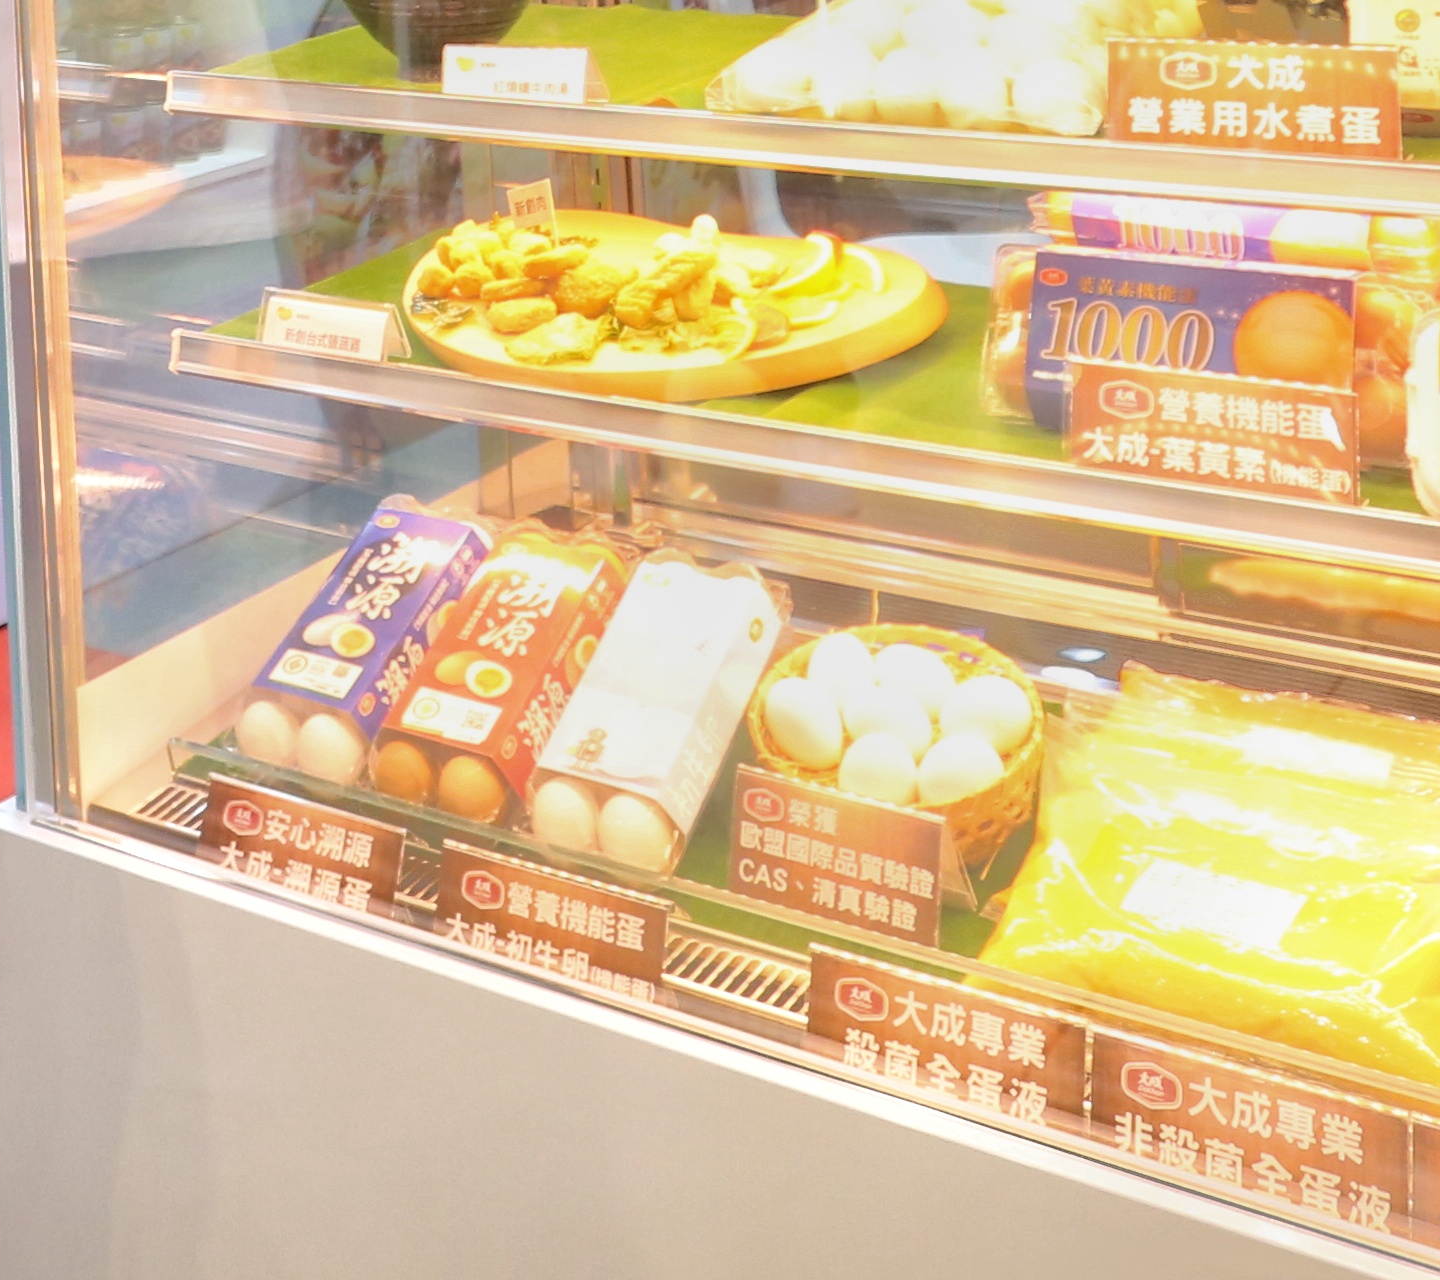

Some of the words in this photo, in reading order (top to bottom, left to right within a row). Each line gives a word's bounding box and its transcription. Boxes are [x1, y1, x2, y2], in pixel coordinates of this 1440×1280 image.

[1226, 53, 1307, 92] 大成
[1128, 95, 1382, 146] 營業用水煮蛋
[1040, 297, 1216, 372] 1000
[1157, 386, 1335, 442] 營養機能蛋
[1082, 425, 1353, 495] 大成-葉黃素(機能蛋)
[263, 806, 375, 870] 安心溯源
[786, 800, 838, 837] 榮獲
[737, 858, 919, 932] CAS、清真驗證
[738, 820, 936, 900] 歐盟國際品質驗證
[504, 880, 646, 953] 營養機能蛋
[893, 990, 1048, 1071] 大成專業
[842, 1026, 1049, 1128] 殺菌全蛋液
[1186, 1076, 1366, 1168] 大成專業
[1113, 1110, 1393, 1240] 非殺菌全蛋液
